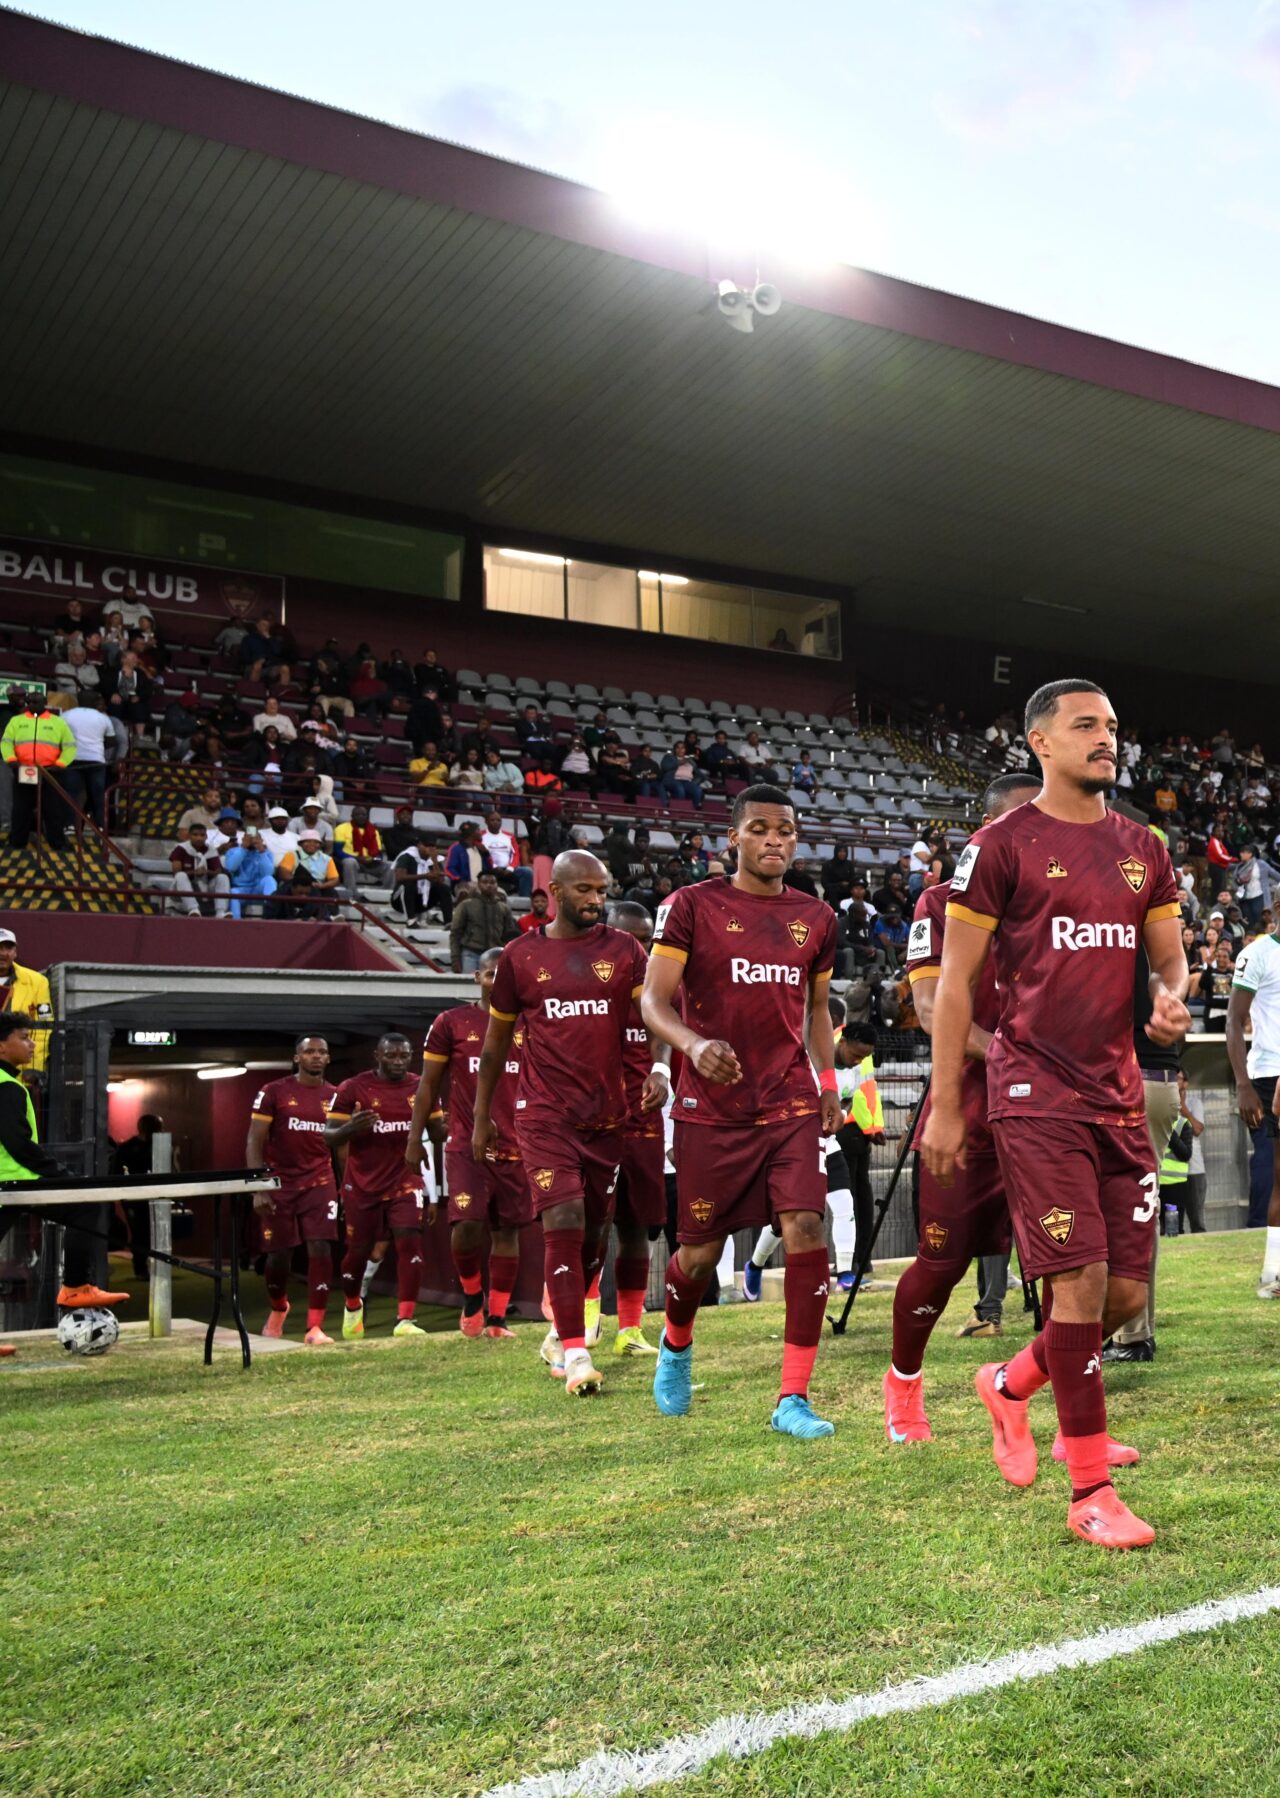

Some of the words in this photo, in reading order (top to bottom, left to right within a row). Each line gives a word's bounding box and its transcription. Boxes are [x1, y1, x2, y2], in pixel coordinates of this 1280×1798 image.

[0, 551, 94, 589] BALL
[101, 566, 199, 603] CLUB
[994, 655, 1011, 684] E
[1051, 916, 1136, 951] Rama
[731, 957, 801, 986] Rama
[544, 998, 608, 1019] Rama
[288, 1117, 326, 1132] Rama
[373, 1120, 412, 1133] Rama
[1133, 1172, 1158, 1223] 3
